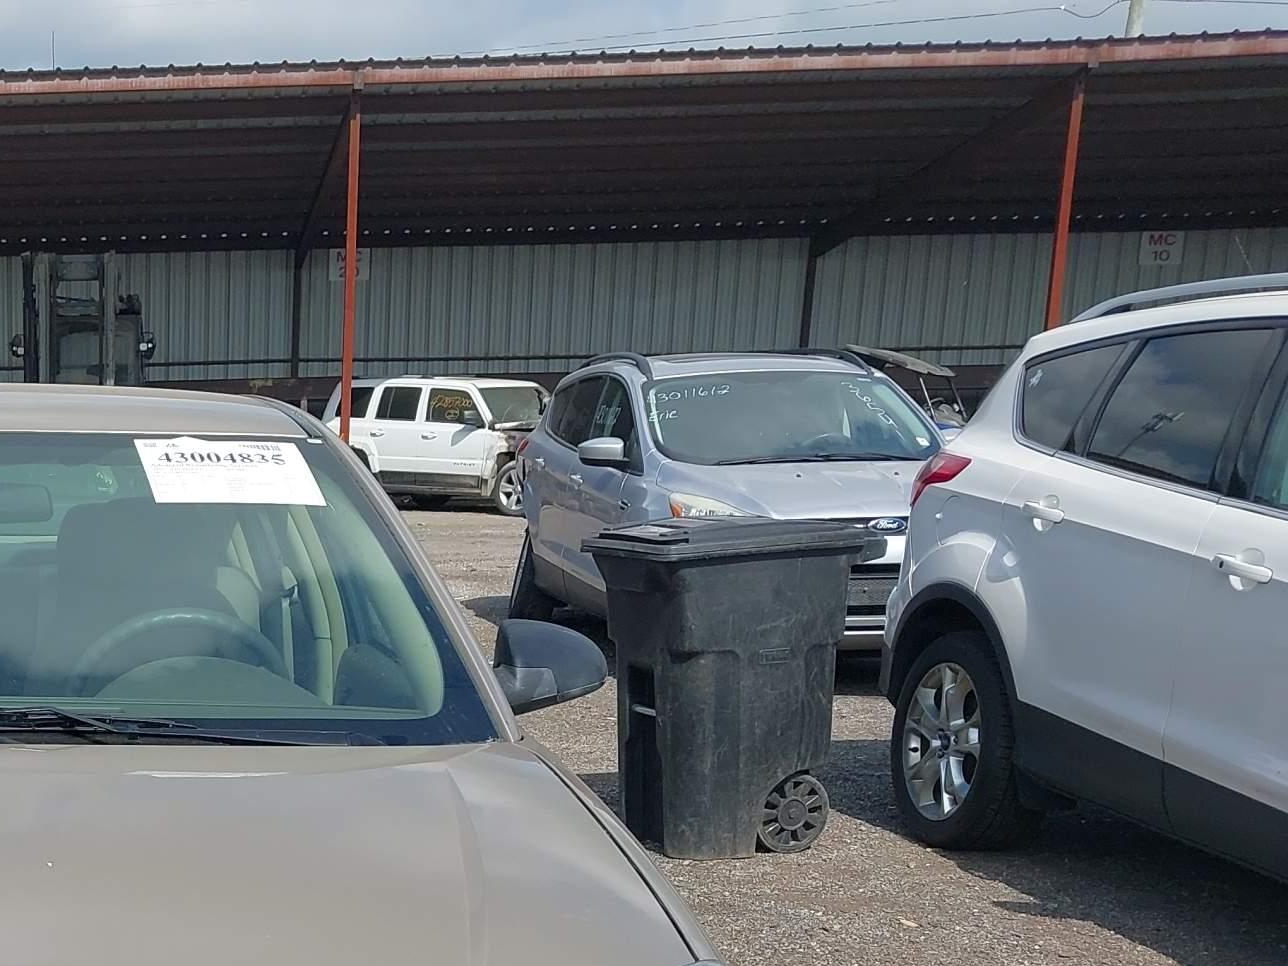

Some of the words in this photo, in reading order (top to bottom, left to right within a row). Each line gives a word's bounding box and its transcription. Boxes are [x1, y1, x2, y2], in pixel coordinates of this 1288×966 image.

[1149, 234, 1176, 246] MC
[1151, 250, 1170, 261] 10
[157, 451, 286, 465] 43004835
[877, 519, 899, 530] Ford
